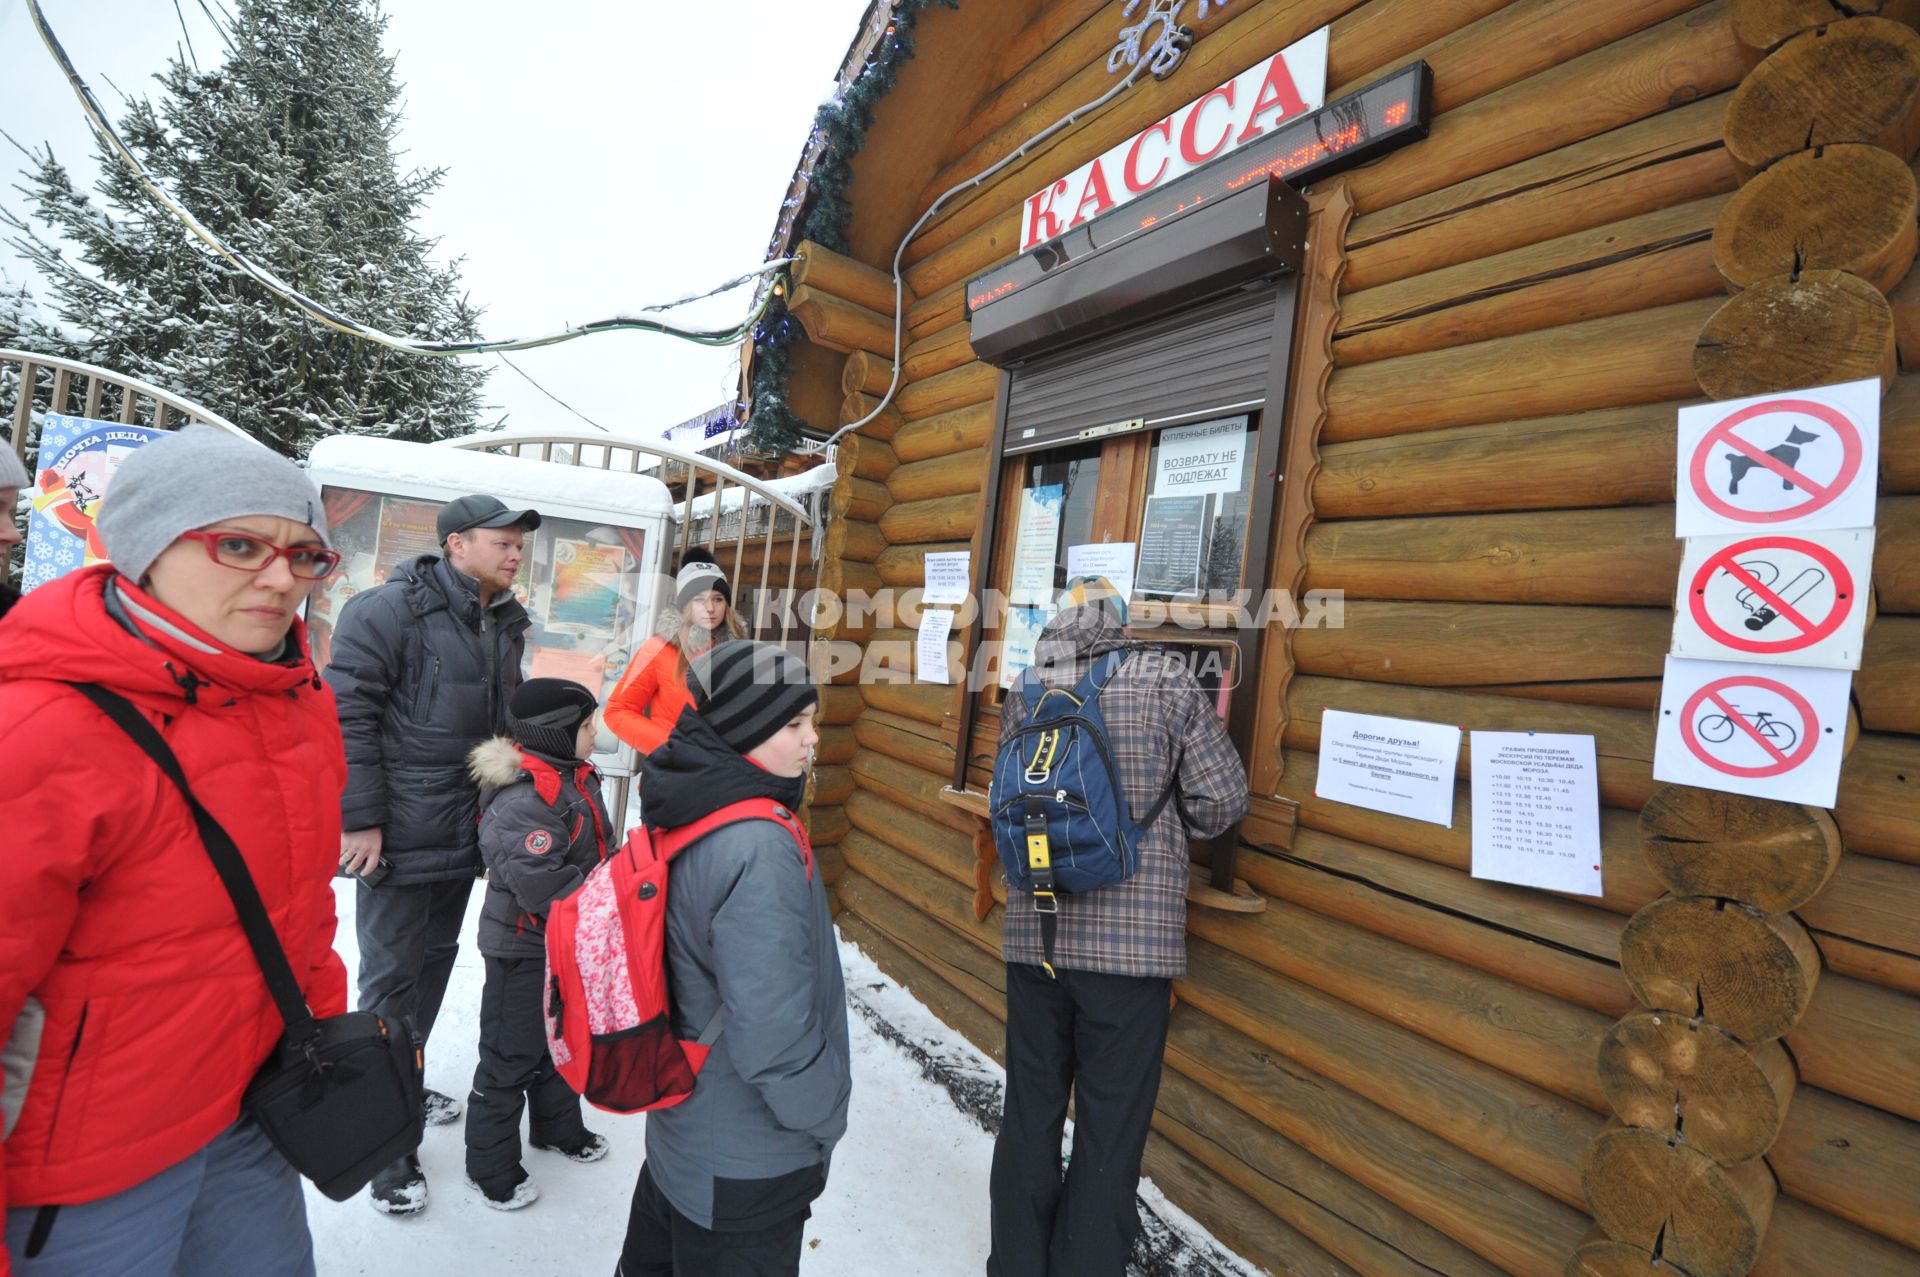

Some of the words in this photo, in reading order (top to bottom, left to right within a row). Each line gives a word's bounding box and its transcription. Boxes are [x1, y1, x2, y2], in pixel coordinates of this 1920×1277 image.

[1023, 53, 1309, 251] КАССА
[1162, 429, 1208, 441] КУПЛЕННЫЕ
[1209, 423, 1242, 436] БИЛЕТЫ
[58, 435, 102, 469] ПОЧТА
[105, 432, 149, 443] ДЕДА
[1164, 452, 1219, 469] ВОЗВРАТУ
[1221, 450, 1237, 462] НЕ
[1168, 467, 1229, 484] ПОДЛЕЖАТ
[1352, 730, 1385, 742] Дорогие
[1387, 737, 1420, 748] друзья!
